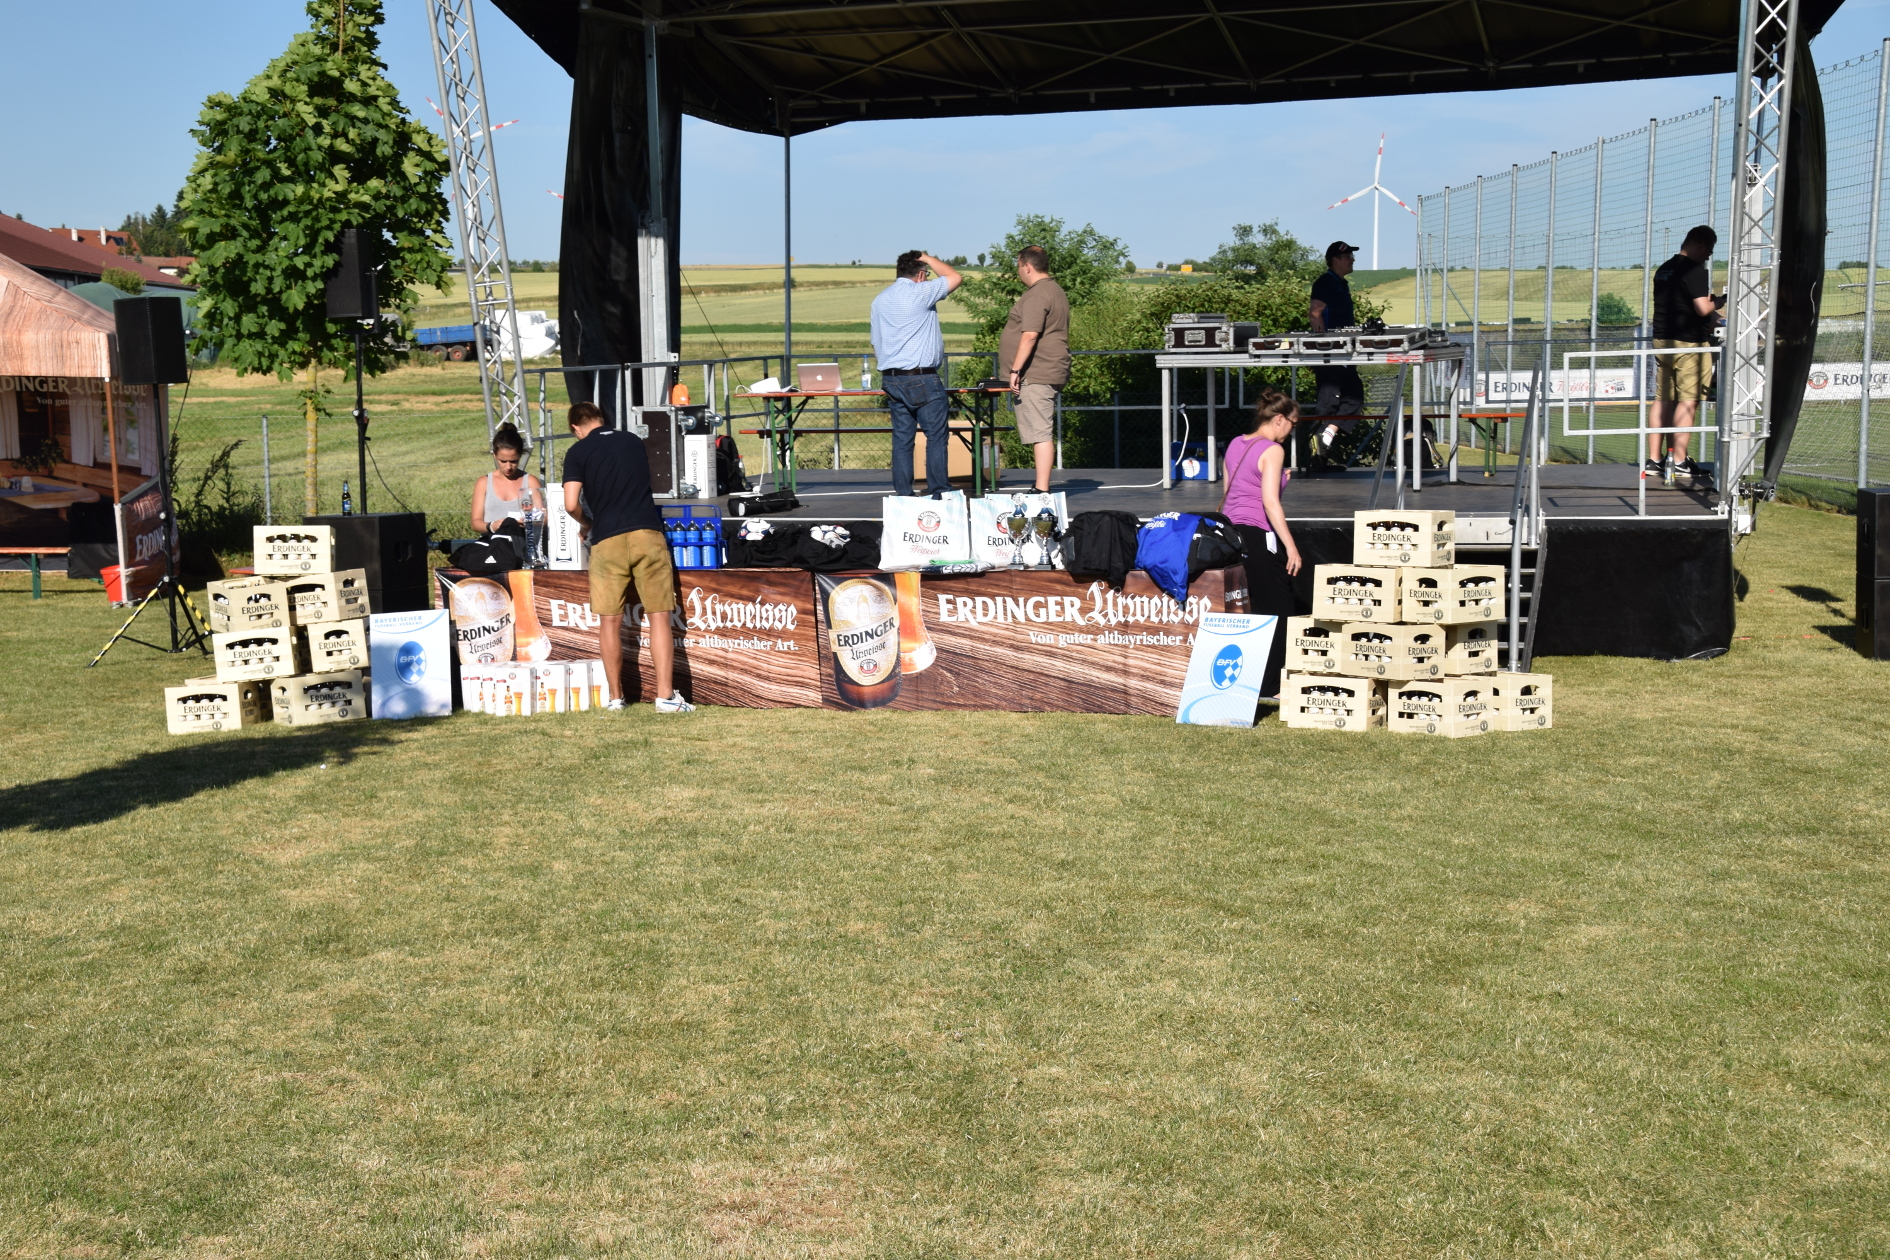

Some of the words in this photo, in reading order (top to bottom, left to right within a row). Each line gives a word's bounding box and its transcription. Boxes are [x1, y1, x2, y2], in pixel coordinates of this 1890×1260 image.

[0, 376, 71, 395] DINGER
[902, 531, 950, 546] ERDINGER
[1372, 532, 1412, 543] ERDINGER
[272, 544, 312, 554] ERDINGER
[289, 593, 322, 604] ERDINGER
[1332, 586, 1375, 599] ERDINGER
[1409, 588, 1443, 600] ERDINGER
[1463, 589, 1493, 599] ERDINGER
[241, 603, 280, 615] ERDINGER
[936, 593, 1087, 626] ERDINGER
[374, 615, 423, 624] BAYERISCHER
[1204, 616, 1251, 625] BAYERISCHER
[836, 616, 896, 648] ERDINGER
[318, 639, 358, 650] ERDINGER
[698, 634, 773, 652] altbayrischer
[775, 638, 799, 652] Art.
[1028, 631, 1055, 645] Von
[1057, 632, 1094, 648] guter
[1097, 630, 1185, 649] altbayrischer
[1295, 637, 1336, 649] ERDINGER
[1463, 640, 1492, 650] ERDINGER
[233, 647, 274, 659] ERDINGER
[1355, 643, 1387, 655] ERDINGER
[1408, 646, 1439, 656] ERDINGER
[310, 691, 348, 703] ERDINGER
[1306, 696, 1348, 709] ERDINGER
[1515, 697, 1546, 708] ERDINGER
[183, 704, 222, 714] ERDINGER
[1402, 701, 1437, 713] ERDINGER
[1458, 702, 1488, 713] ERDINGER
